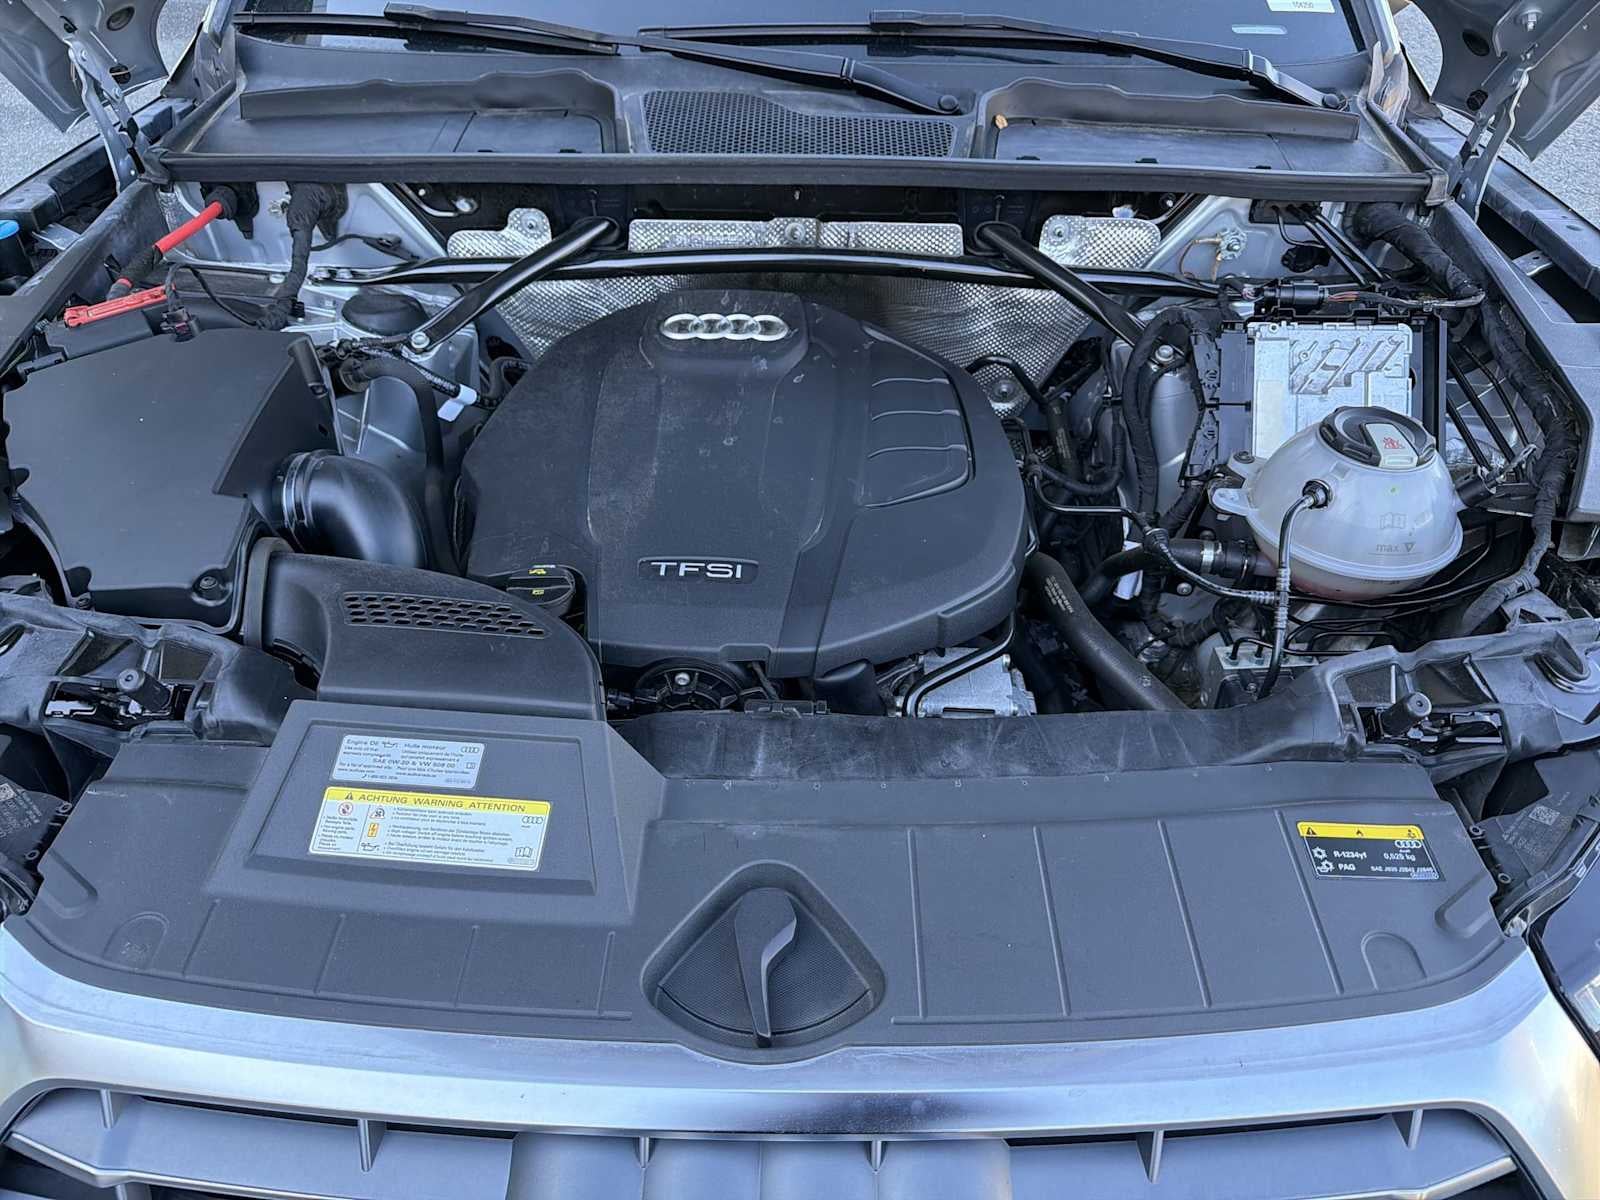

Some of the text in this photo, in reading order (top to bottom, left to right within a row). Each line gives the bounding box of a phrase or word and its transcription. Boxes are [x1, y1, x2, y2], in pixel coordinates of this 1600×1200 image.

[1376, 543, 1399, 551] max
[650, 562, 742, 578] TFSI
[358, 793, 408, 804] ACHTUNG
[413, 797, 464, 808] WARNING
[469, 801, 526, 813] ATTENTION
[1405, 853, 1416, 862] kg
[1338, 863, 1357, 871] PAG
